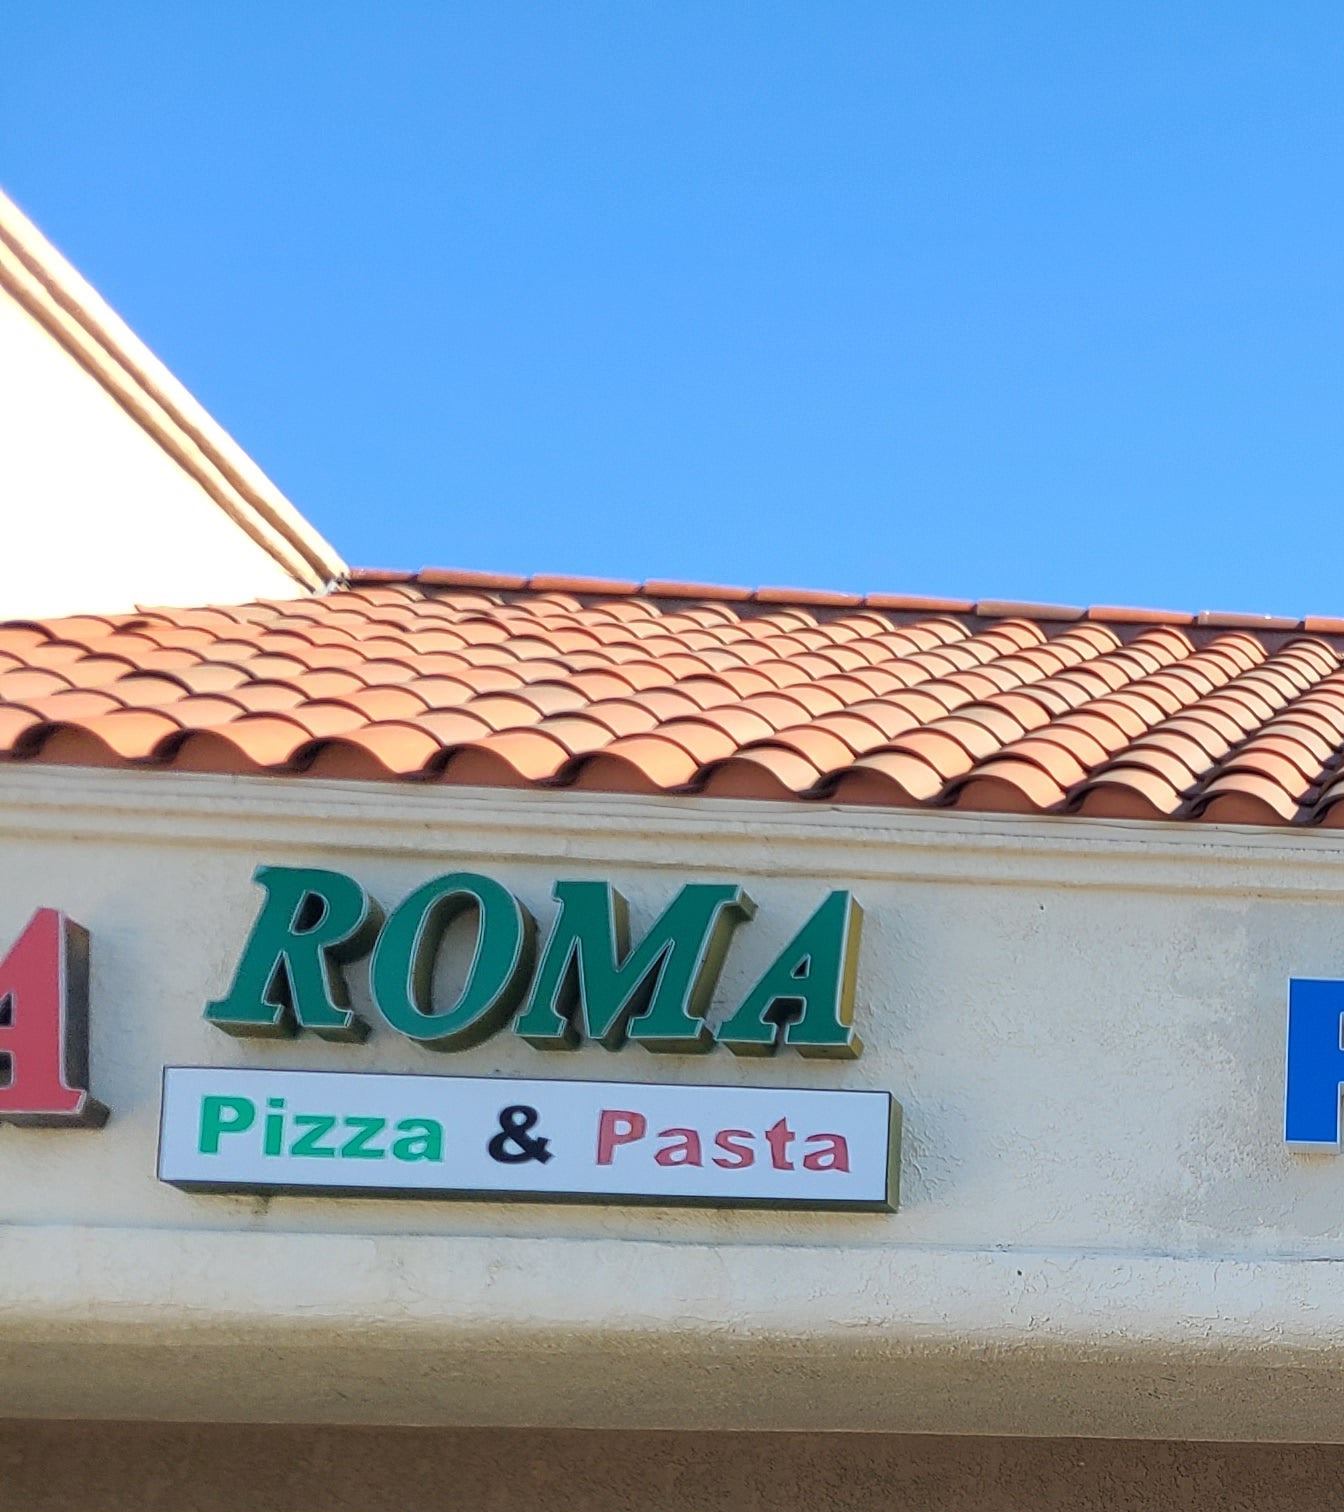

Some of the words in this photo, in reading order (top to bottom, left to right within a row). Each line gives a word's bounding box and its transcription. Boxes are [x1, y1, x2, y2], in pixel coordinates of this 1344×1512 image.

[203, 865, 862, 1055] ROMA
[199, 1094, 445, 1163] Pizza
[486, 1104, 554, 1166] &
[596, 1108, 852, 1174] Pasta
